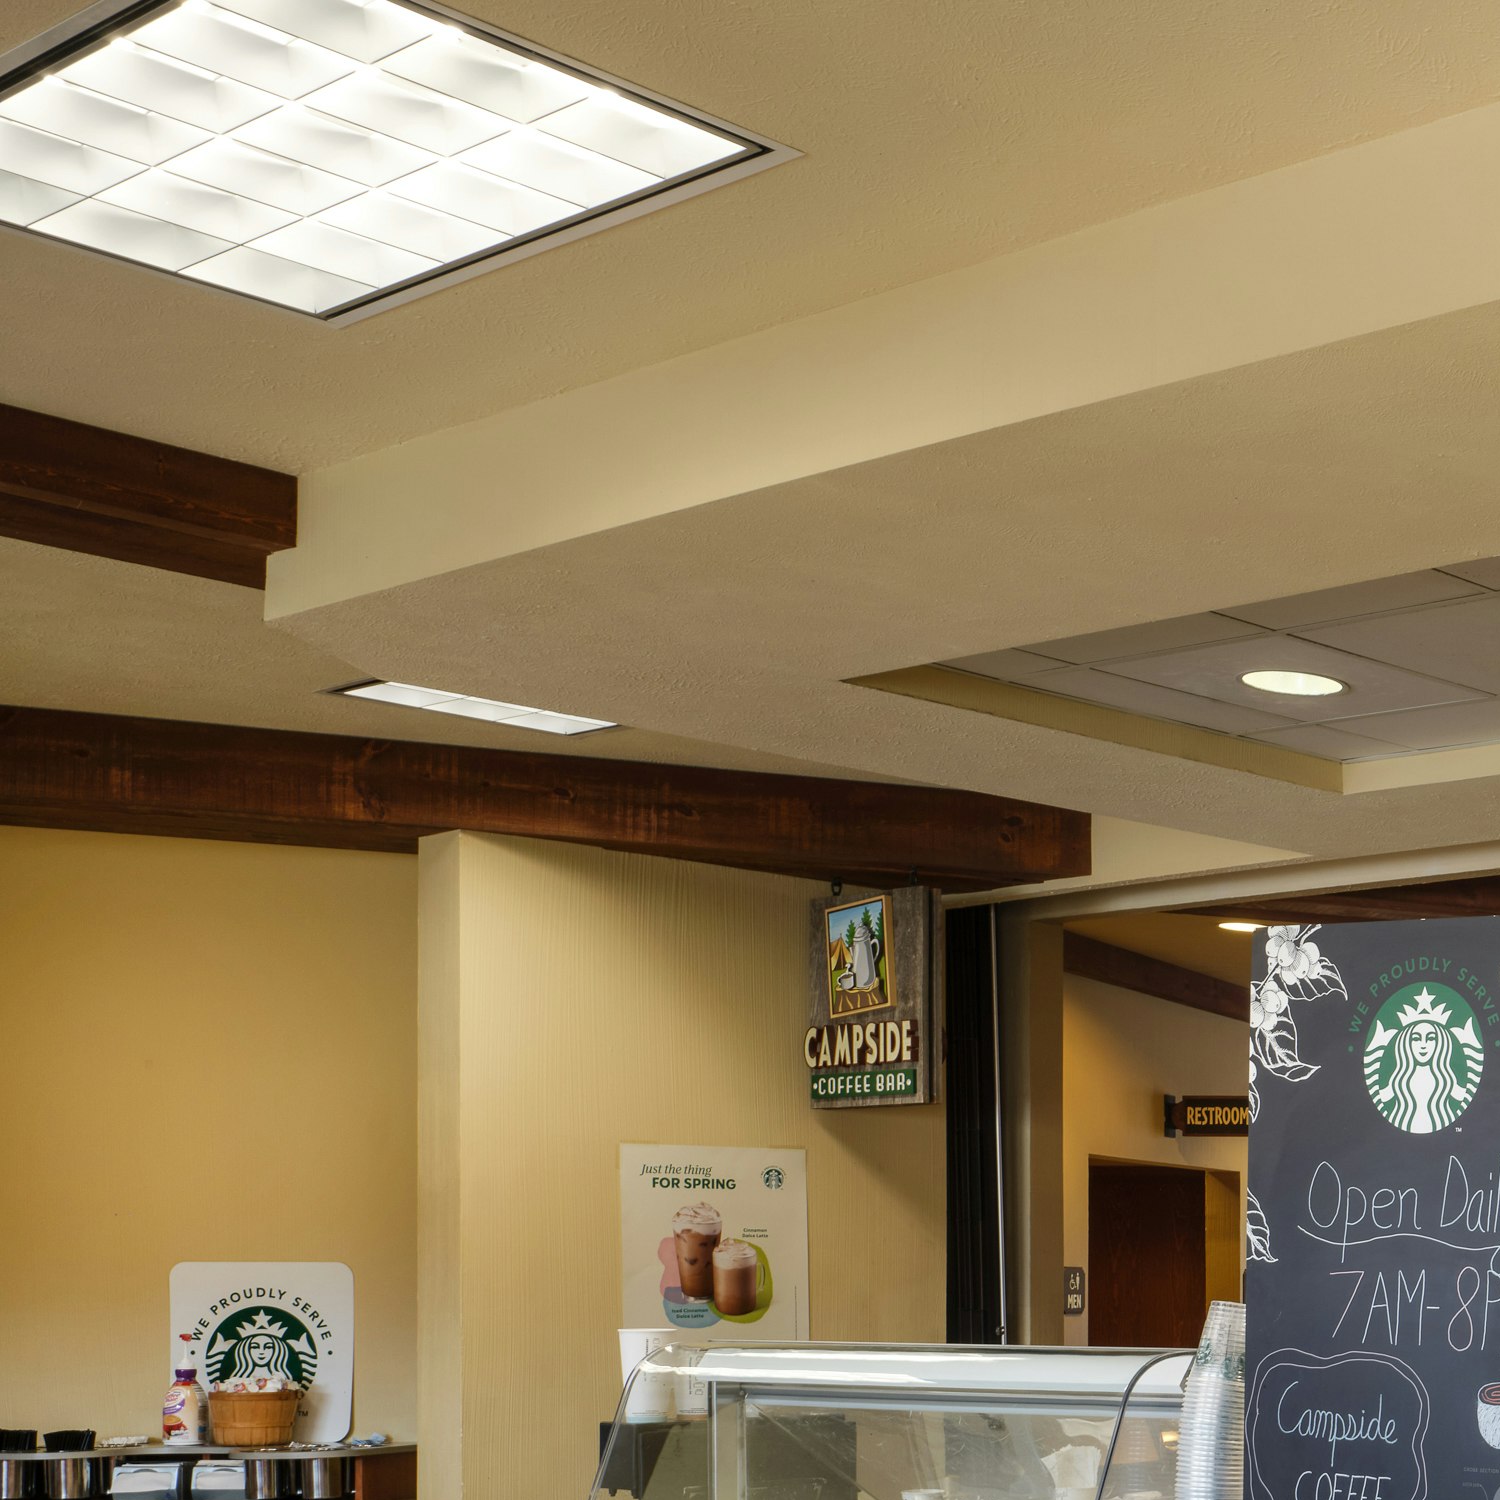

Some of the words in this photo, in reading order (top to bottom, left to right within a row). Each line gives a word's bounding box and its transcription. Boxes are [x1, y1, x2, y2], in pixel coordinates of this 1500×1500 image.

[1348, 1002, 1369, 1033] WE
[1369, 957, 1452, 997] PROUDLY
[1457, 968, 1500, 1026] SERVE
[804, 1020, 912, 1068] CAMPSIDE
[818, 1075, 870, 1095] COFFEE
[876, 1073, 905, 1092] BAR
[640, 1164, 662, 1176] Just
[664, 1164, 682, 1174] the
[684, 1164, 712, 1177] thing
[652, 1177, 680, 1188] FOR
[684, 1178, 736, 1189] SPRING
[1307, 1161, 1422, 1263] Open
[192, 1318, 210, 1341] WE
[210, 1287, 287, 1316] PROUDLY
[292, 1296, 332, 1340] SERVE
[1067, 1294, 1082, 1309] MEN
[1277, 1381, 1399, 1460] Campside
